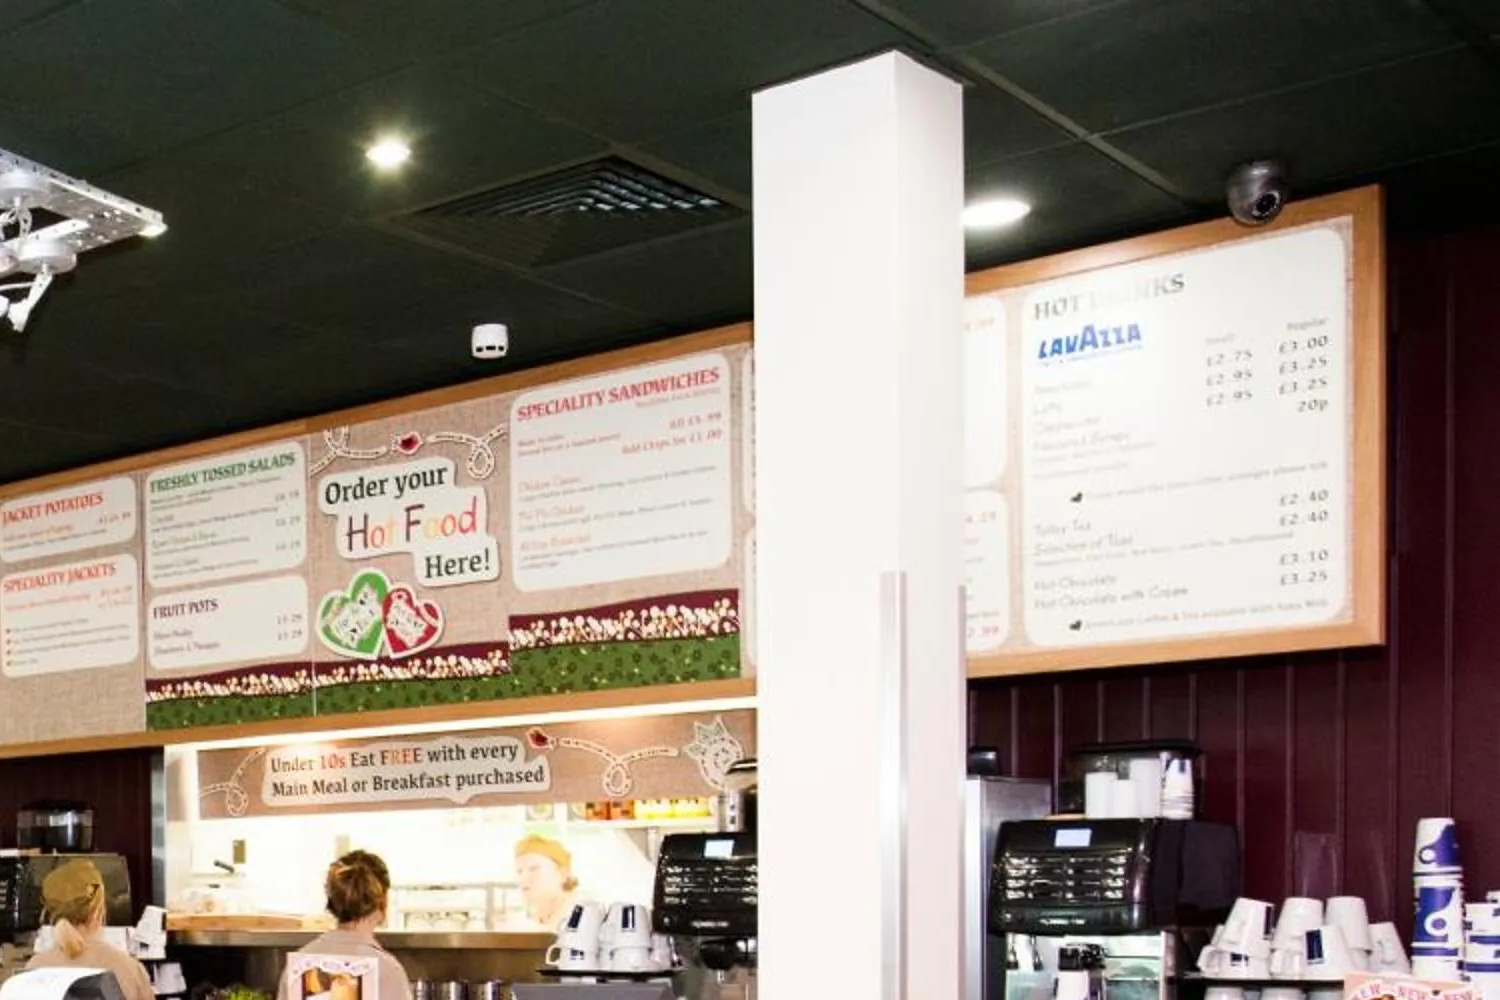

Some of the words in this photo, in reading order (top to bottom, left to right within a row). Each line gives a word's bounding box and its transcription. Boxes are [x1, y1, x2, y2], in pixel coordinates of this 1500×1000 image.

[1035, 295, 1080, 320] HOT
[1090, 273, 1185, 309] DNKS
[1038, 323, 1142, 359] LAVAZZA
[516, 389, 606, 422] SPECIALITY
[607, 366, 721, 404] SANDWICHES
[151, 471, 199, 493] FRESHLY
[202, 462, 247, 483] TOSSED
[248, 452, 296, 472] SALADS
[324, 475, 389, 505] Order
[393, 466, 449, 499] your
[2, 503, 42, 526] JACKET
[45, 493, 104, 516] POTATOES
[346, 511, 398, 553] Hot
[404, 495, 478, 543] Food
[424, 547, 491, 579] Here!
[153, 603, 188, 620] FRUIT
[189, 598, 219, 615] POTS
[271, 755, 315, 774] Under
[320, 754, 346, 770] 10s
[350, 750, 376, 767] Eat
[380, 747, 423, 766] FREE
[427, 744, 467, 763] with
[470, 744, 519, 763] every
[271, 780, 309, 797] Main
[311, 777, 348, 795] Meal
[351, 780, 368, 793] or
[373, 772, 451, 791] Breakfast
[455, 765, 546, 791] purchased
